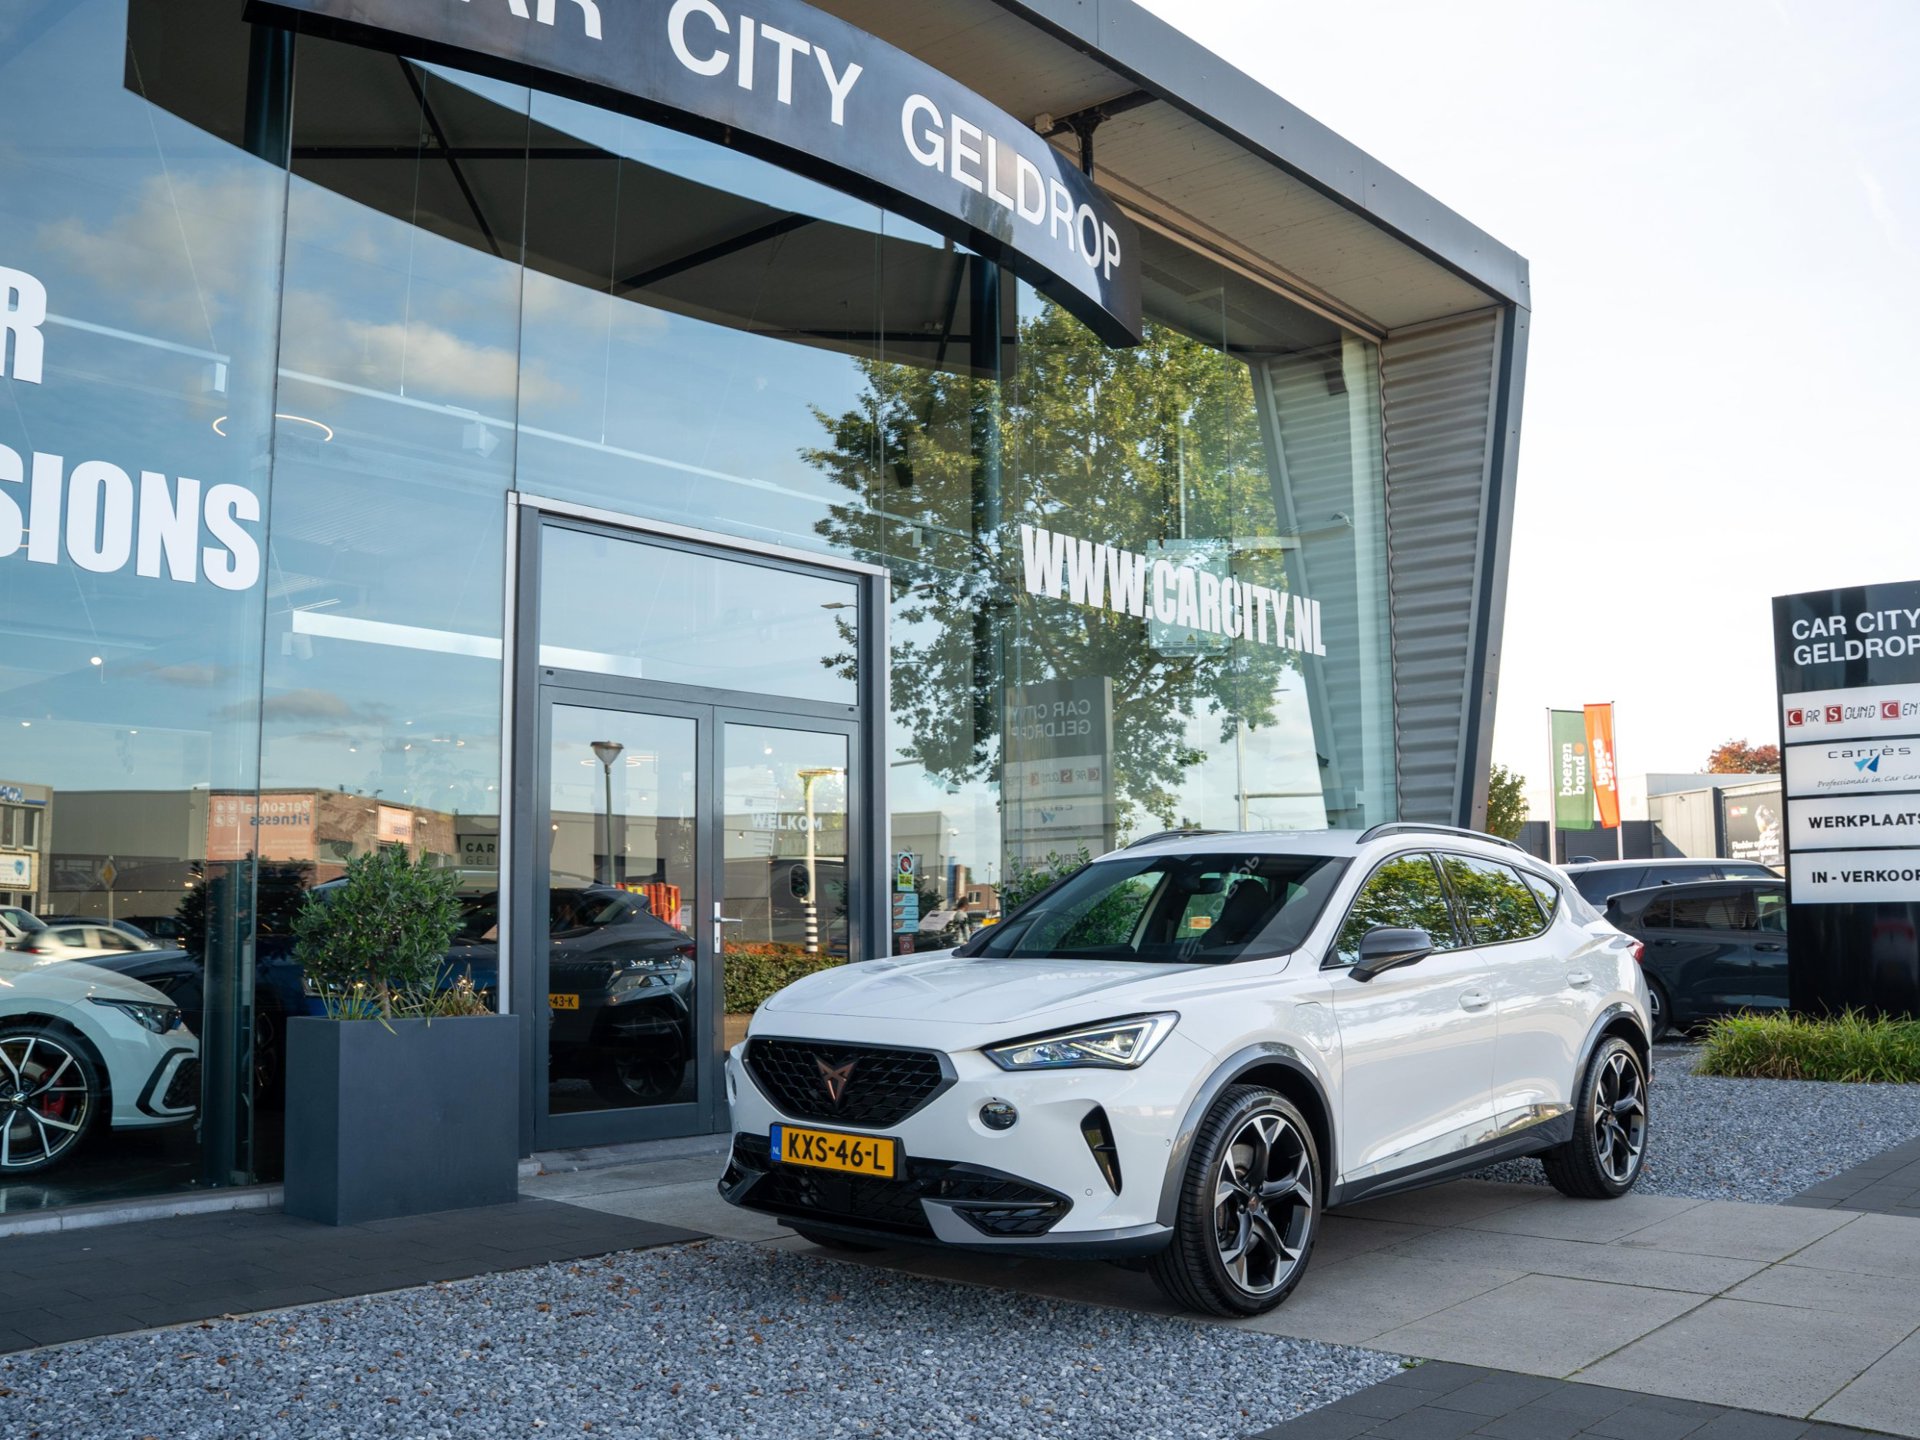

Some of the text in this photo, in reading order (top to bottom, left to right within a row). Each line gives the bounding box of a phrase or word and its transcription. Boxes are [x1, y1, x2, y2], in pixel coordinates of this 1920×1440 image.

[667, 0, 1121, 281] CITY GELDROP
[0, 265, 47, 384] R
[1021, 524, 1326, 656] WWW.CARCITY.NL
[1792, 608, 1920, 640] CAR CITY
[1793, 634, 1920, 666] GELDROP
[1787, 701, 1920, 726] CAR SOUND CEN
[1828, 745, 1911, 759] carrès
[1559, 742, 1573, 797] boeren
[1572, 755, 1585, 796] bond
[752, 813, 823, 832] WELKOM
[465, 842, 496, 854] CAR
[1812, 871, 1828, 883] IN
[772, 1146, 781, 1155] NL
[788, 1132, 886, 1171] KXS-46-L
